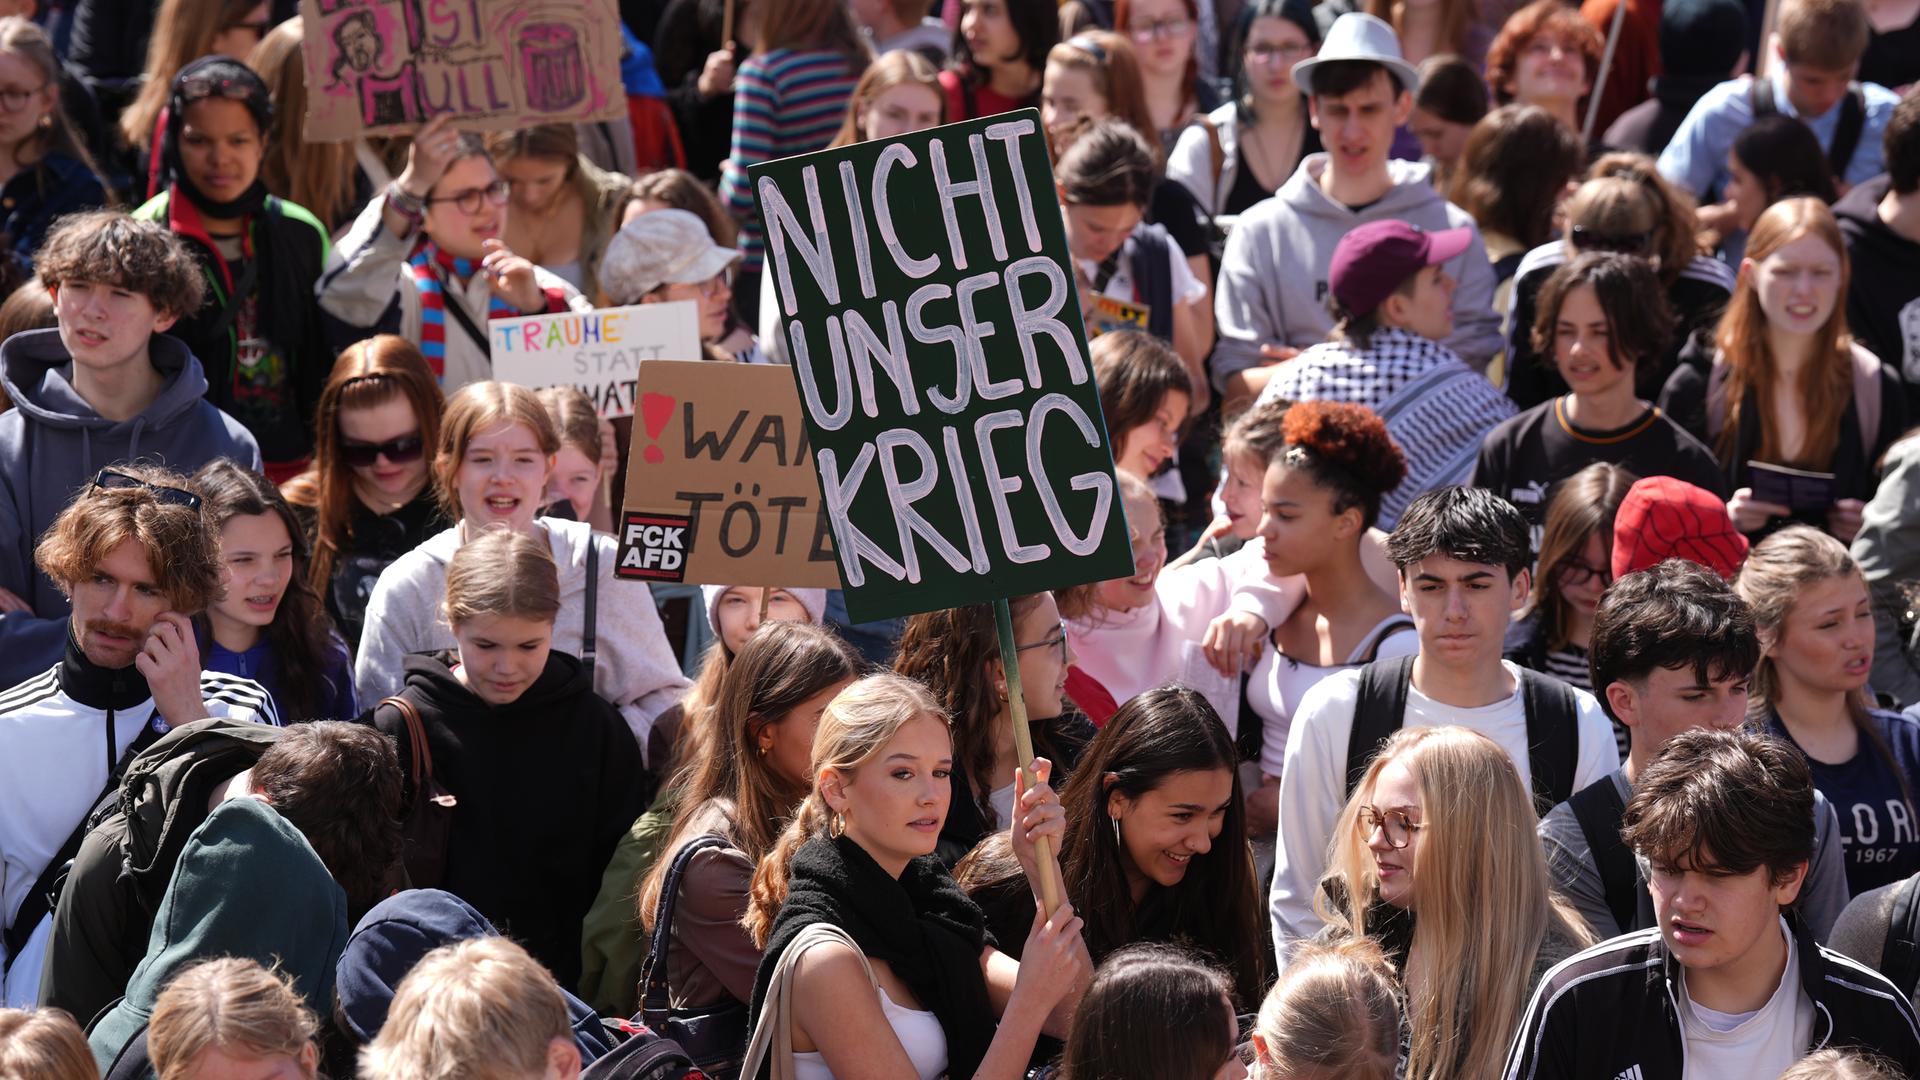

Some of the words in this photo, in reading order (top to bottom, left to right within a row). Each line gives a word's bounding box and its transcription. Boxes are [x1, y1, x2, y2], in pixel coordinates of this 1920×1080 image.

[757, 119, 1042, 316] NICHT
[789, 255, 1088, 431] UNSER
[625, 524, 686, 549] FCK
[817, 393, 1112, 587] KRIEG
[621, 548, 682, 570] AFD
[1856, 848, 1898, 863] 1967
